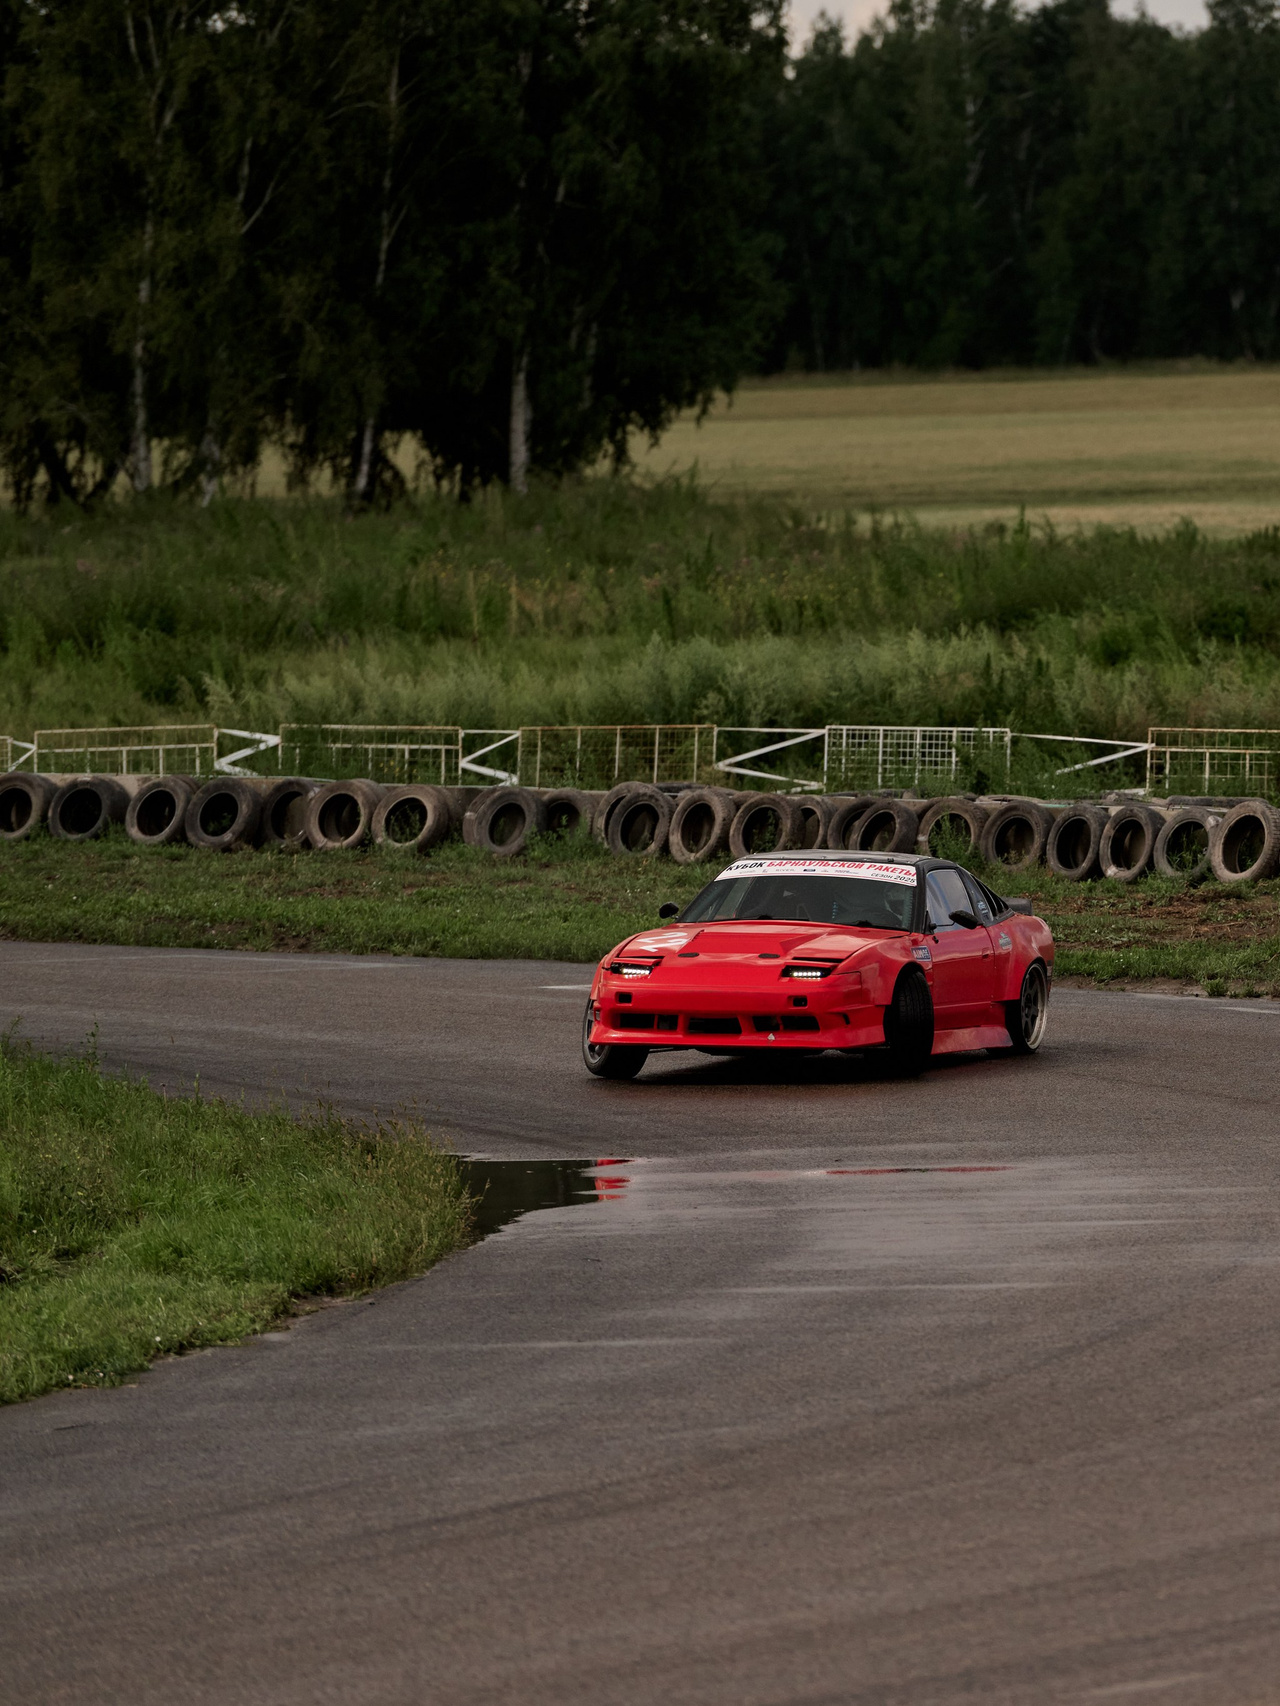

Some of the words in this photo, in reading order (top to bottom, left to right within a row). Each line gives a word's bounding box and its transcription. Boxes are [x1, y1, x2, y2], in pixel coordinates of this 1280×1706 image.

[726, 861, 767, 872] КУБОК
[767, 860, 865, 869] БАРНАУЛЬСКОЙ
[866, 863, 917, 877] РАКЕТЫ
[893, 875, 916, 883] 2025
